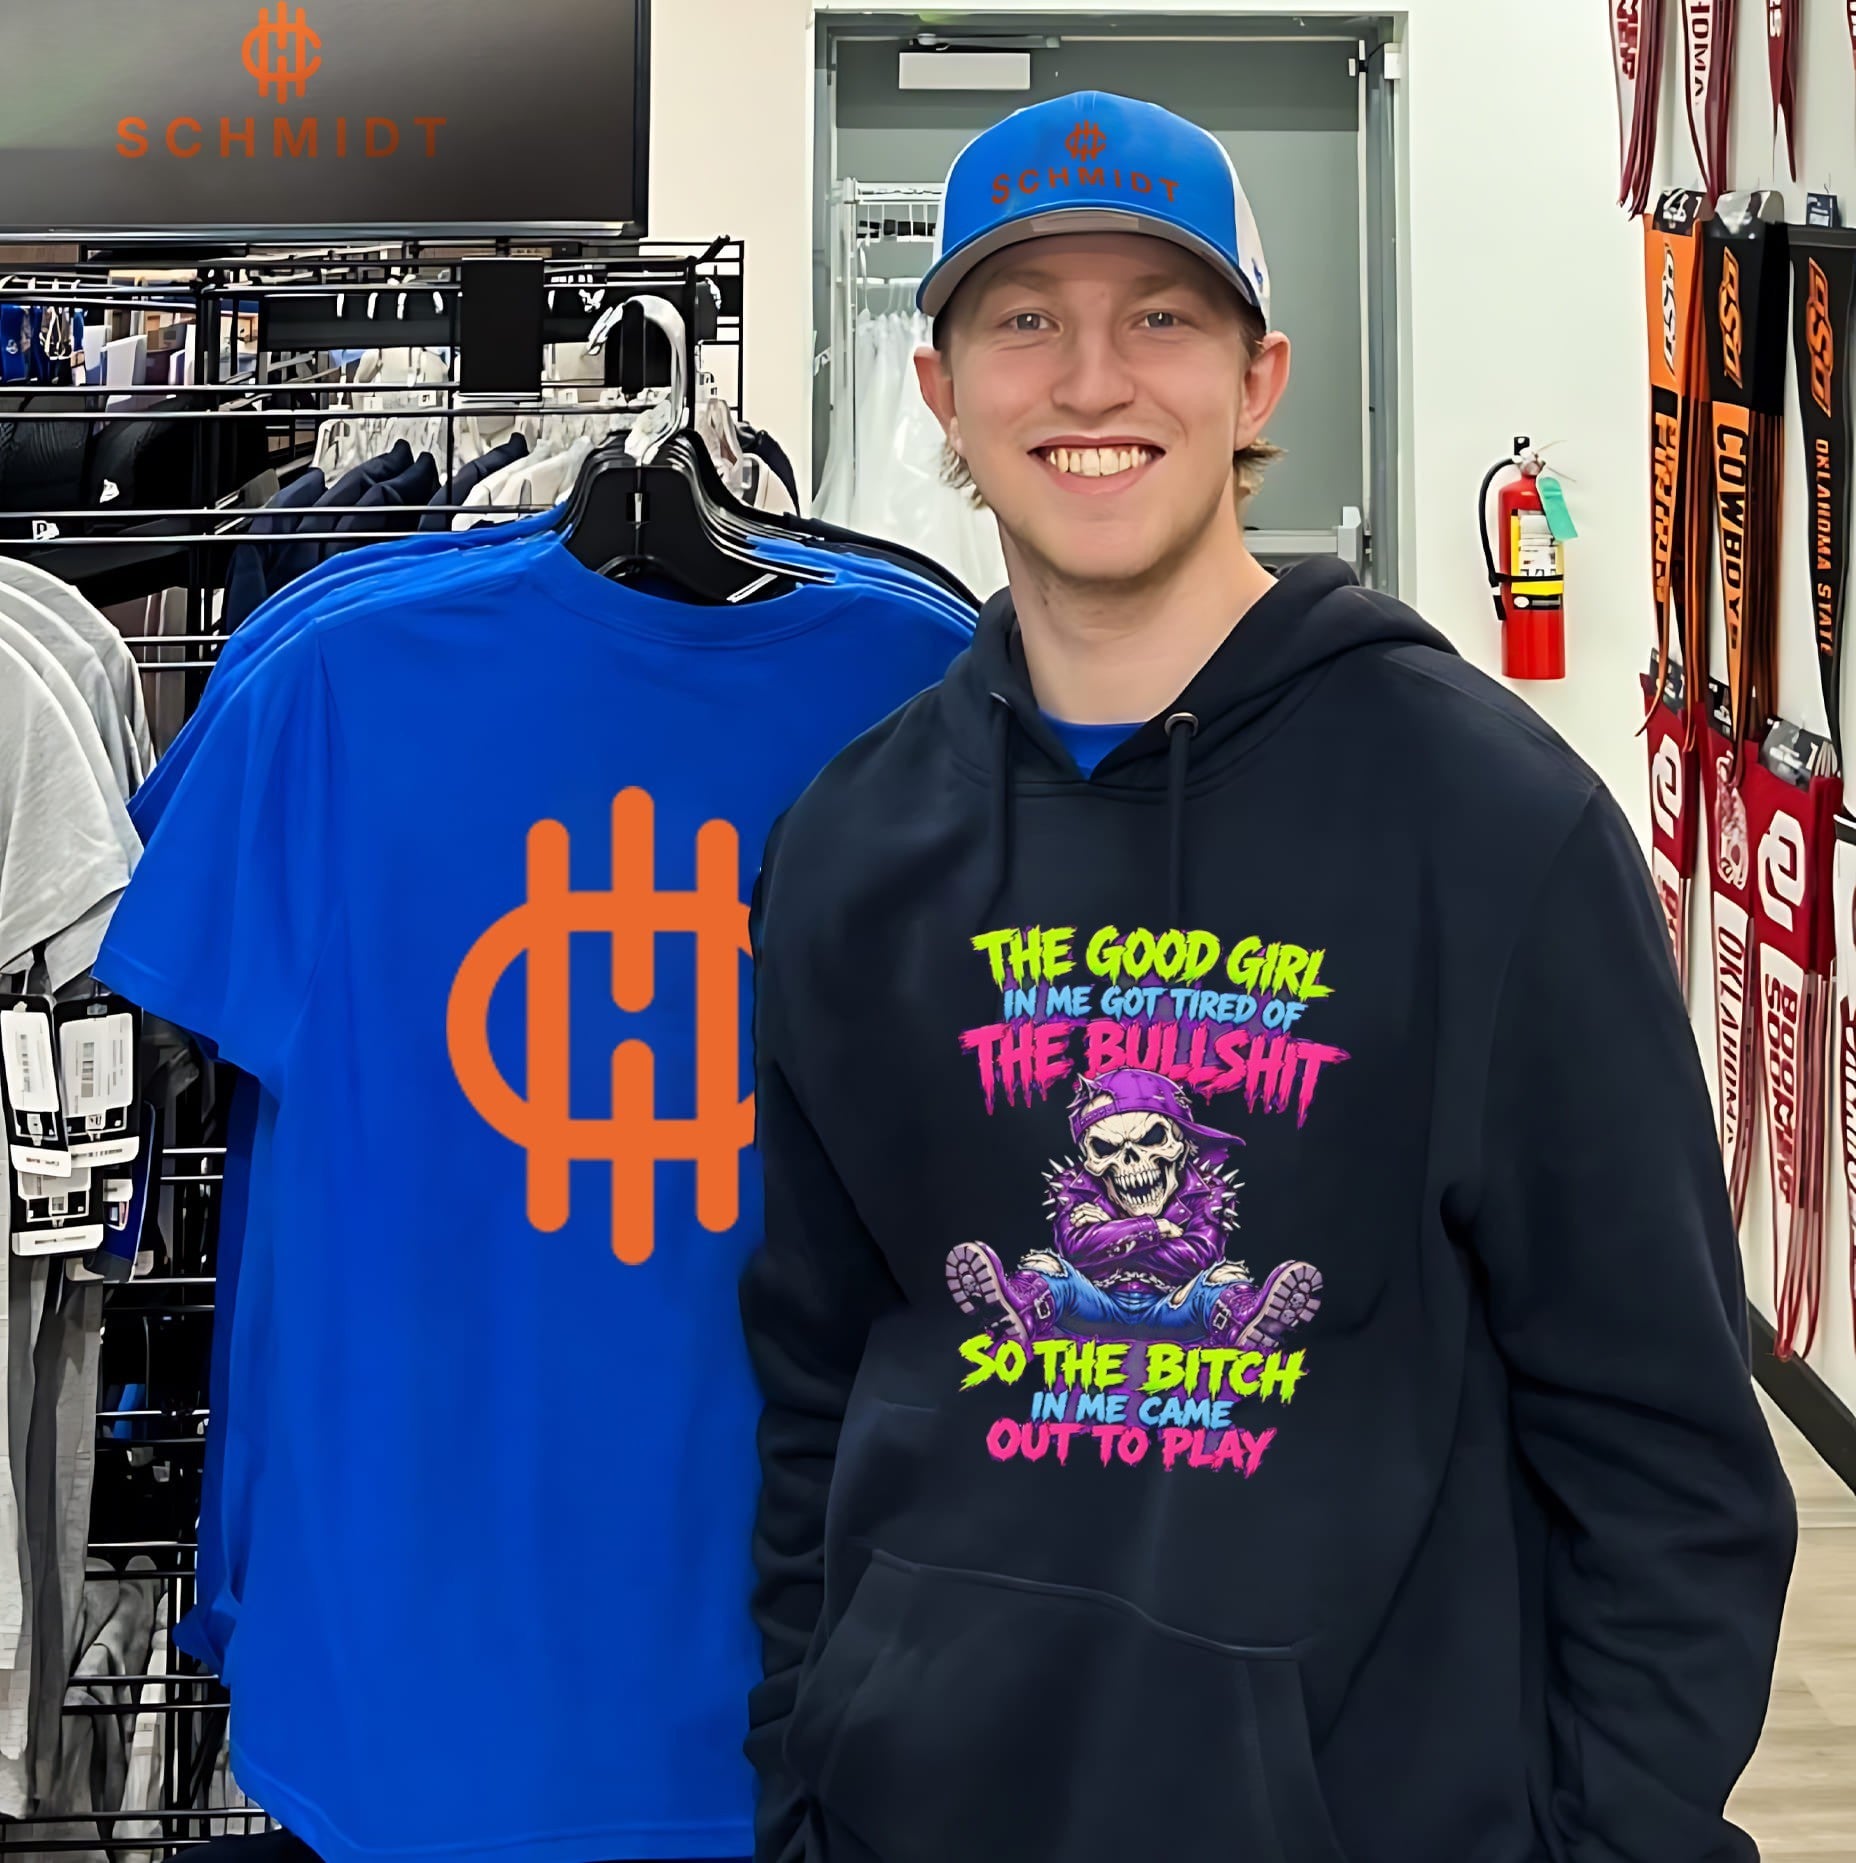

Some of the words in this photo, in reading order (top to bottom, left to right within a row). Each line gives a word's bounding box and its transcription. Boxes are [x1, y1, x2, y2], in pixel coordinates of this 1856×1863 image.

[116, 117, 447, 158] SCHMIDT
[991, 167, 1180, 204] SCHMIDT
[1815, 439, 1833, 571] OKLAHOMA
[970, 924, 1078, 994] THE
[1086, 924, 1221, 987] GOOD
[1226, 935, 1336, 1001] GIRL
[1003, 986, 1038, 1023] IN
[1044, 984, 1094, 1021] ME
[1101, 986, 1168, 1020] GOT
[1170, 986, 1258, 1024] TIRED
[1262, 998, 1309, 1033] OF
[1719, 926, 1746, 1145] OKLAHOMA
[958, 1020, 1074, 1115] THE
[1083, 1019, 1351, 1128] BULLSHIT
[958, 1333, 1028, 1393] SO
[1032, 1336, 1131, 1393] THE
[1138, 1343, 1307, 1404] BITCH
[1031, 1391, 1069, 1422] IN
[1075, 1392, 1130, 1424] ME
[1139, 1397, 1234, 1429] CAME
[986, 1418, 1085, 1467] OUT
[1091, 1427, 1149, 1468] TO
[1160, 1427, 1278, 1478] PLAY
